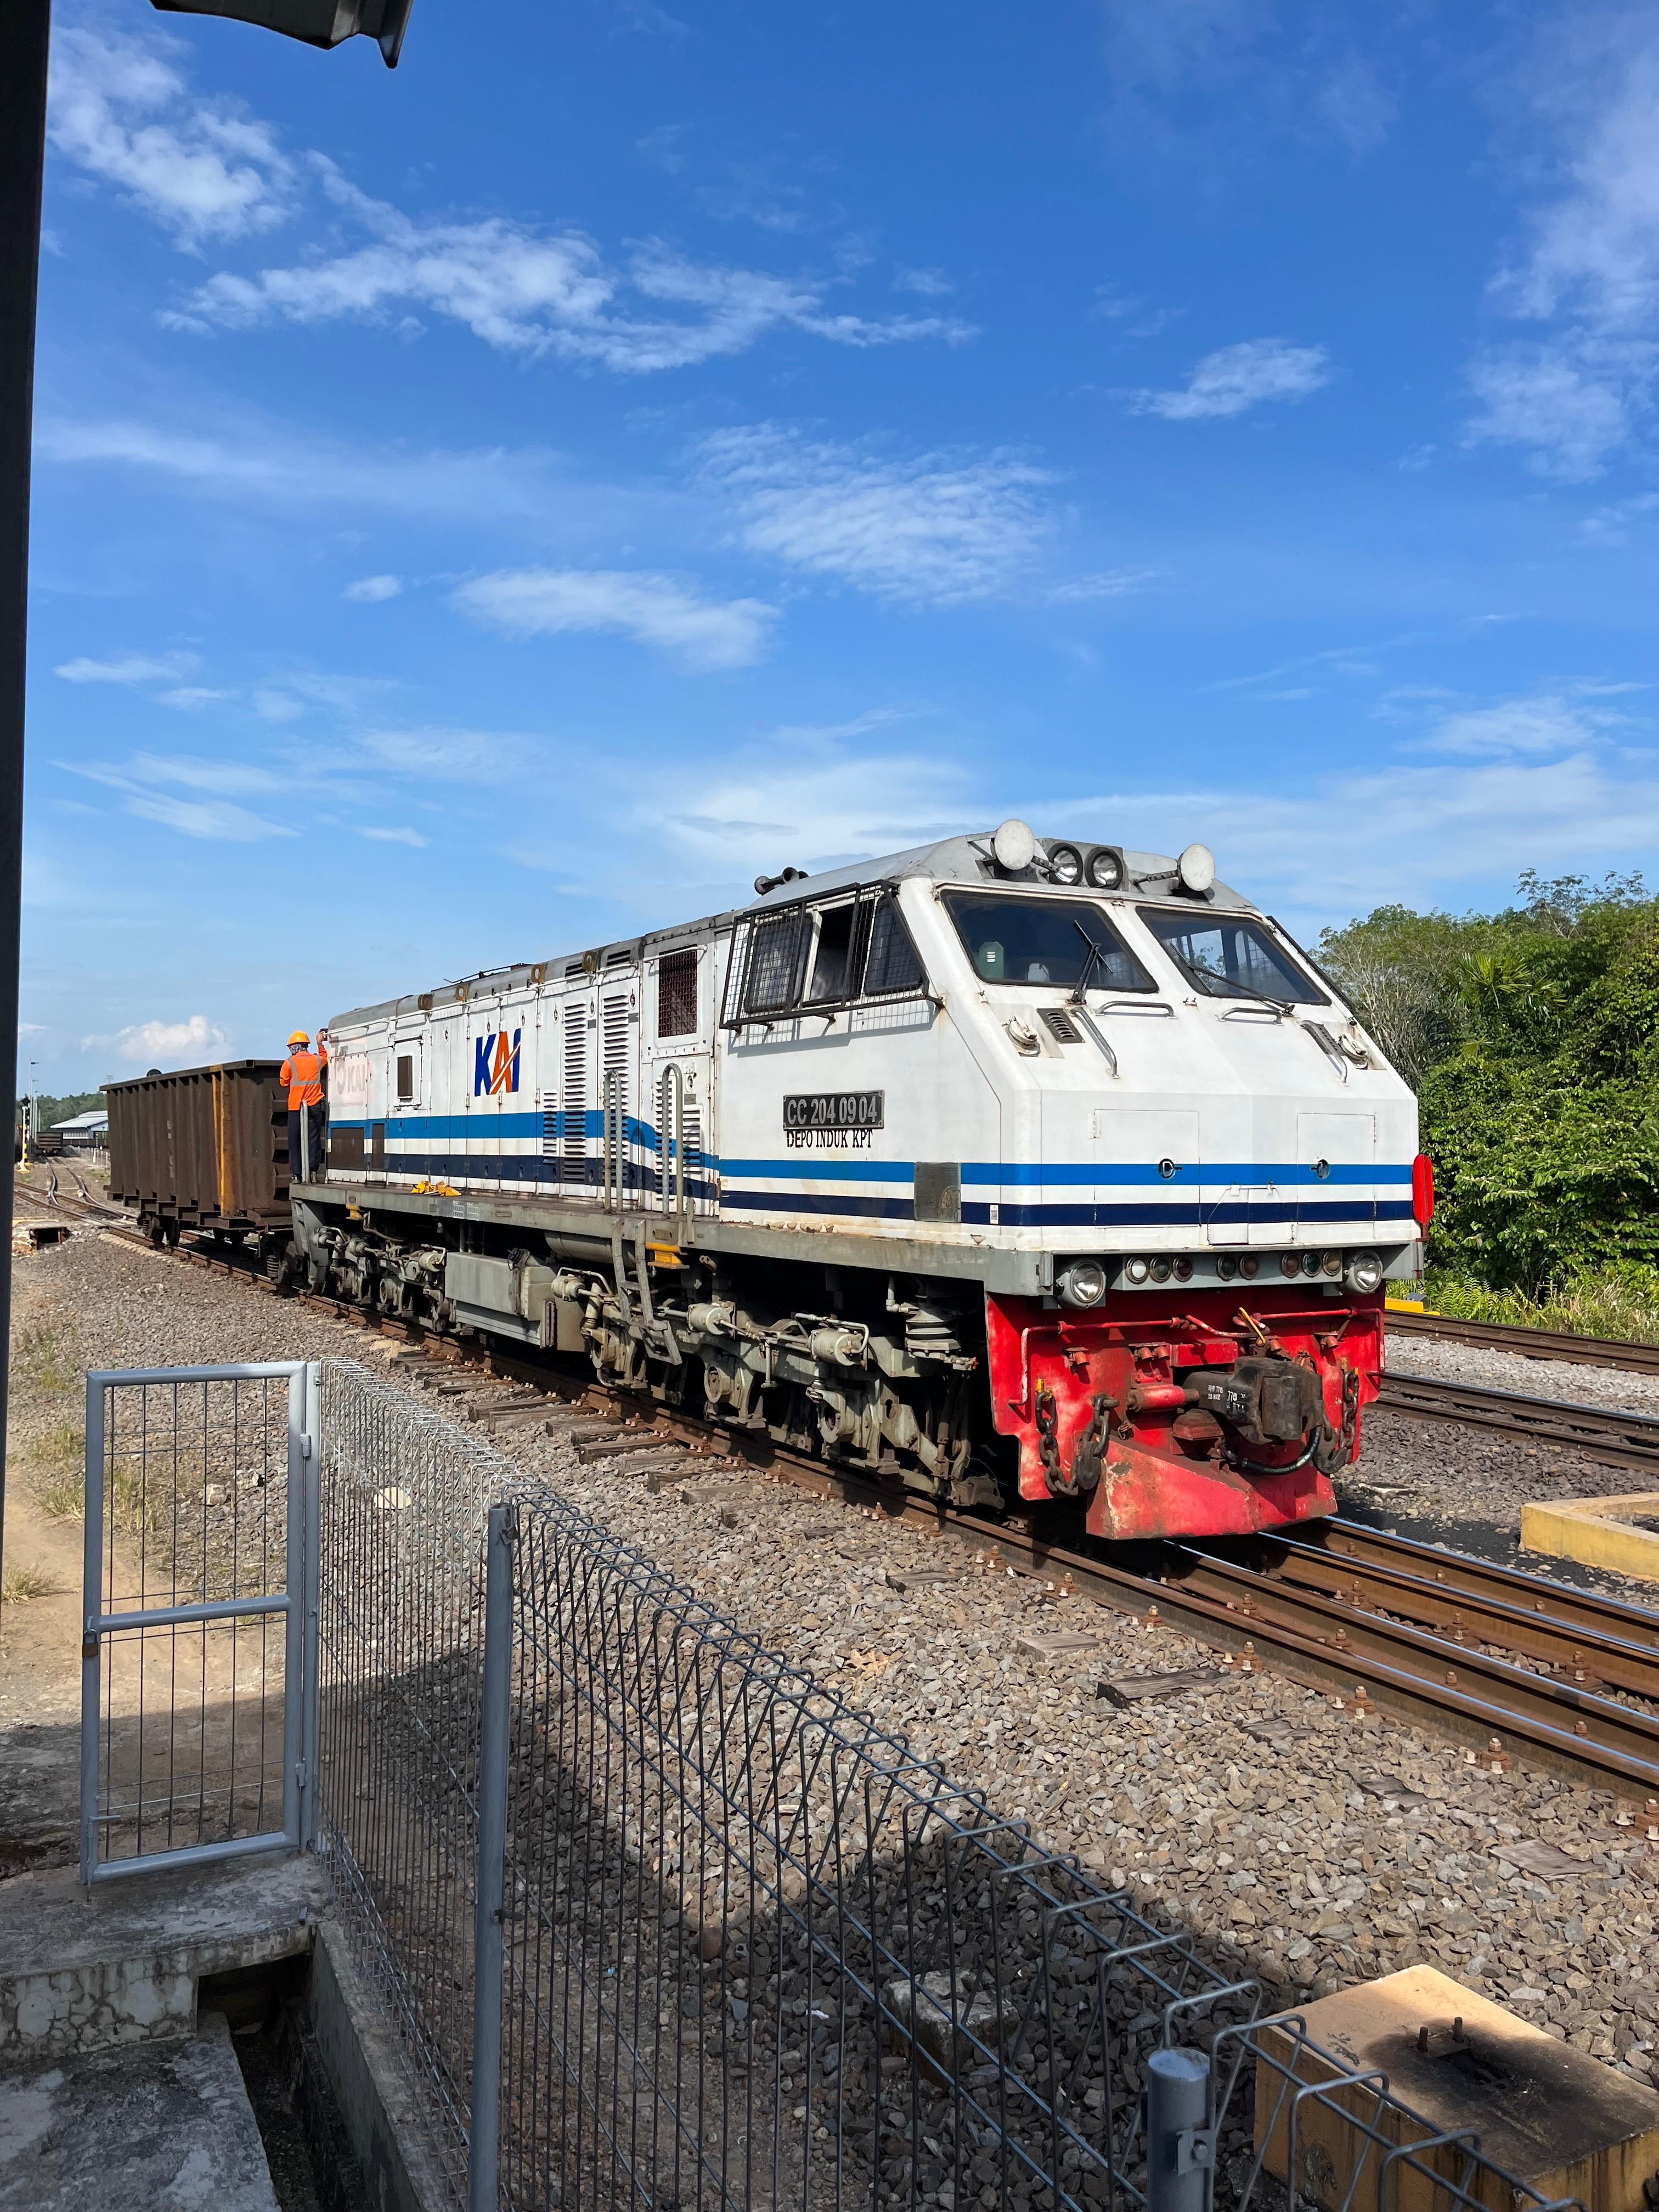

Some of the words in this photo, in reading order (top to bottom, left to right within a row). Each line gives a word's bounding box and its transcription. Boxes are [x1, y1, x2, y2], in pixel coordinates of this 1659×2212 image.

[475, 1028, 521, 1097] KAI
[787, 1099, 807, 1125] CC
[810, 1098, 836, 1124] 204
[787, 1130, 813, 1148] DEPO
[816, 1130, 848, 1148] INDUK
[852, 1129, 873, 1148] KPT
